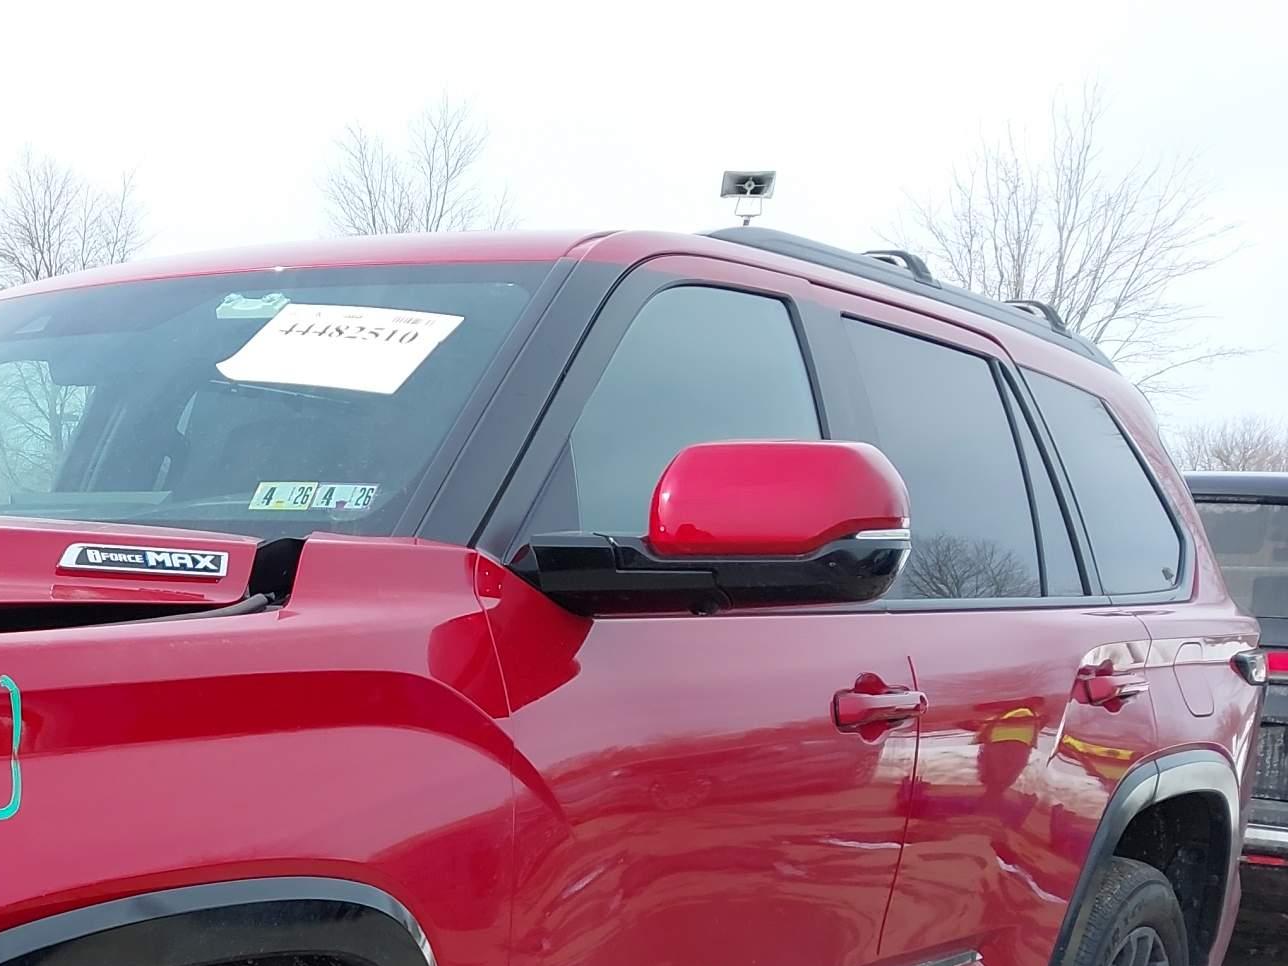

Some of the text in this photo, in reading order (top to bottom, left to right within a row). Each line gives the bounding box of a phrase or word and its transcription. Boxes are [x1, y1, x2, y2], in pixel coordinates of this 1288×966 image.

[279, 322, 420, 345] 44482510
[262, 486, 313, 506] 4 26
[322, 486, 374, 506] 4 26
[145, 550, 219, 571] MAX
